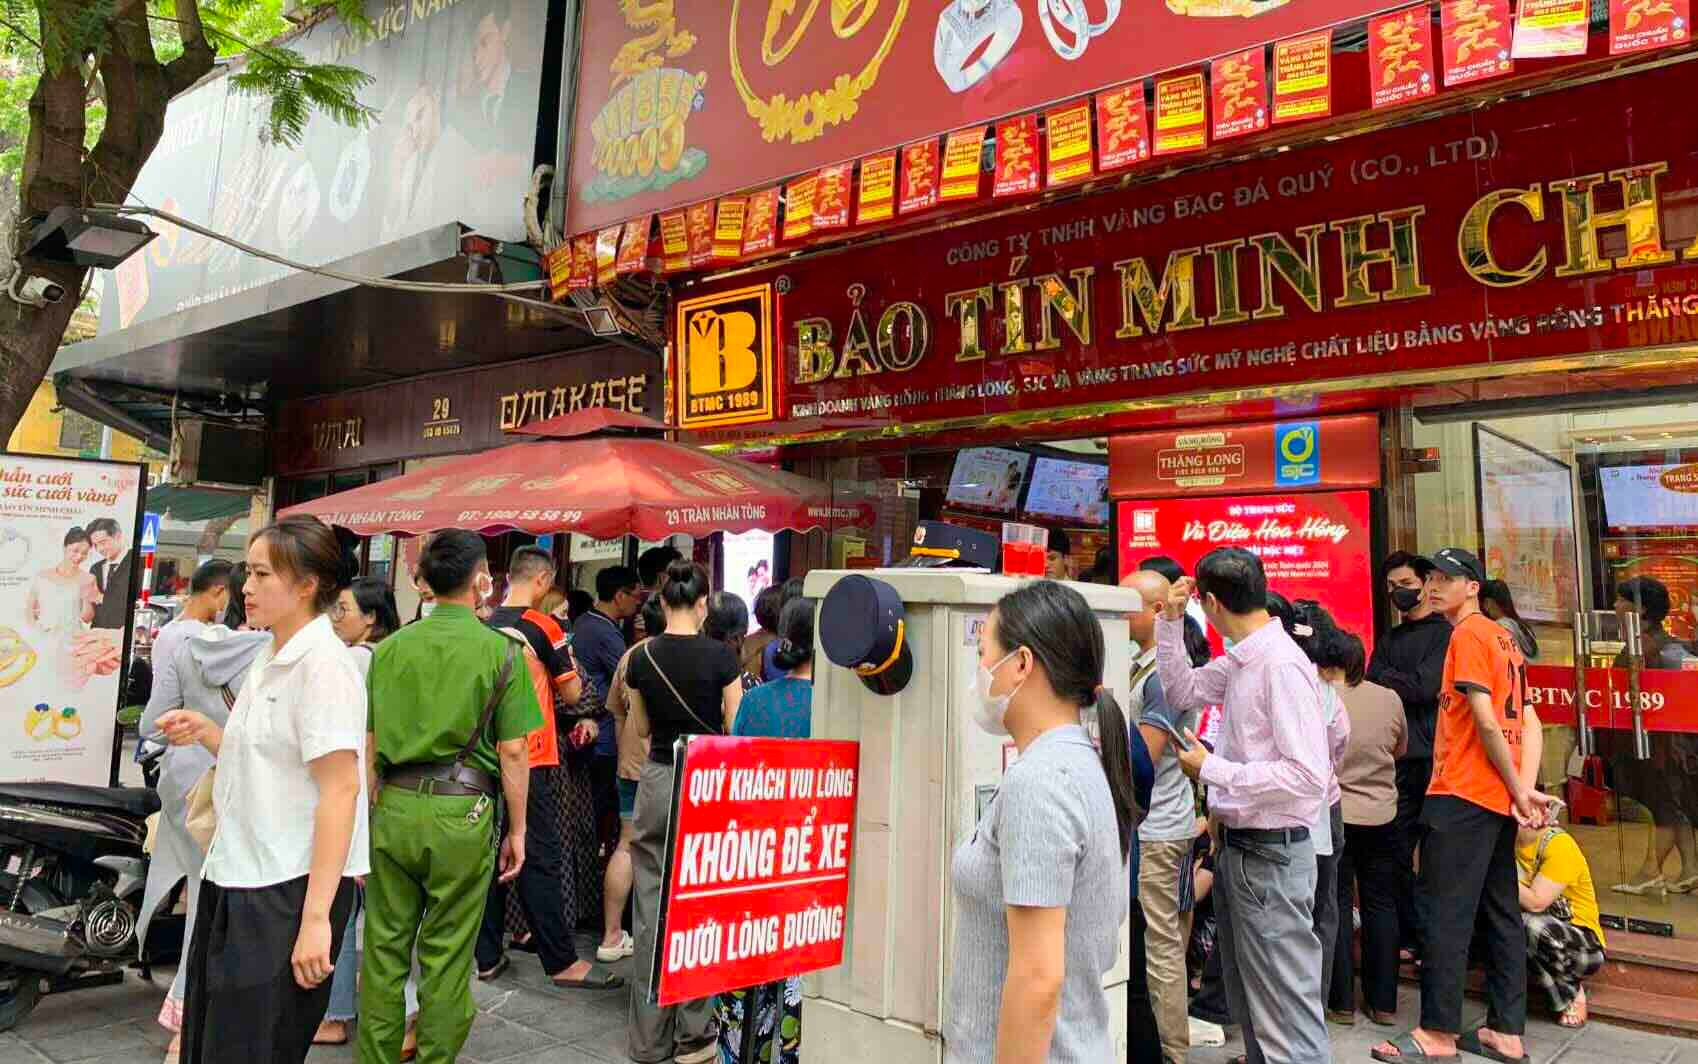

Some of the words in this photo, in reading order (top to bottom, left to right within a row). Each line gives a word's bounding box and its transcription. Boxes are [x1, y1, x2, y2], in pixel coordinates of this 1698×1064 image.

[946, 239, 1000, 265] CÔNG
[1006, 231, 1032, 253] TY
[1040, 217, 1094, 246] TNHH
[1103, 206, 1166, 233] VÀNG
[1174, 191, 1225, 220] BẠC
[1234, 176, 1269, 207] ĐÁ
[1278, 164, 1334, 198] QUÝ
[1350, 154, 1419, 185] (CO.,
[1428, 130, 1499, 168] LTD)
[792, 283, 928, 385] BẢO
[945, 255, 1095, 362] TÍN
[1113, 204, 1431, 338] MINH
[1458, 160, 1698, 288] CH
[860, 392, 892, 411] VÀNG
[1023, 376, 1047, 392] SJC
[1052, 368, 1071, 389] VÀ
[1120, 360, 1175, 382] TRANG
[1176, 349, 1211, 375] SỨC
[1215, 347, 1242, 371] MỸ
[1247, 341, 1297, 367] NGHỆ
[1301, 332, 1350, 360] CHẤT
[1356, 329, 1398, 356] LIỆU
[1404, 319, 1463, 348] BẰNG
[1469, 313, 1530, 341] VÀNG
[1610, 294, 1698, 324] THĂNG
[432, 398, 449, 420] 29
[500, 374, 645, 429] OMAKASE
[690, 395, 724, 414] BTMC
[727, 390, 759, 411] 1989
[1160, 454, 1203, 469] THĂNG
[1206, 452, 1241, 467] LONG
[36, 486, 73, 500] cưới
[77, 486, 118, 506] vàng
[665, 509, 680, 525] 29
[740, 502, 766, 519] TÔNG
[1208, 519, 1250, 542] Điệu
[1254, 517, 1293, 540] Hoa
[1296, 515, 1350, 544] Hồng
[1528, 686, 1602, 708] BTMC
[689, 762, 725, 807] QUÝ
[729, 761, 786, 801] KHÁCH
[789, 768, 814, 800] VUI
[816, 761, 854, 798] LÒNG
[679, 819, 777, 887] KHÔNG
[781, 806, 817, 875] ĐỂ
[817, 823, 849, 870] XE
[668, 917, 723, 973] DƯỚI
[726, 911, 780, 961] LÒNG
[783, 900, 844, 950] ĐƯỜNG
